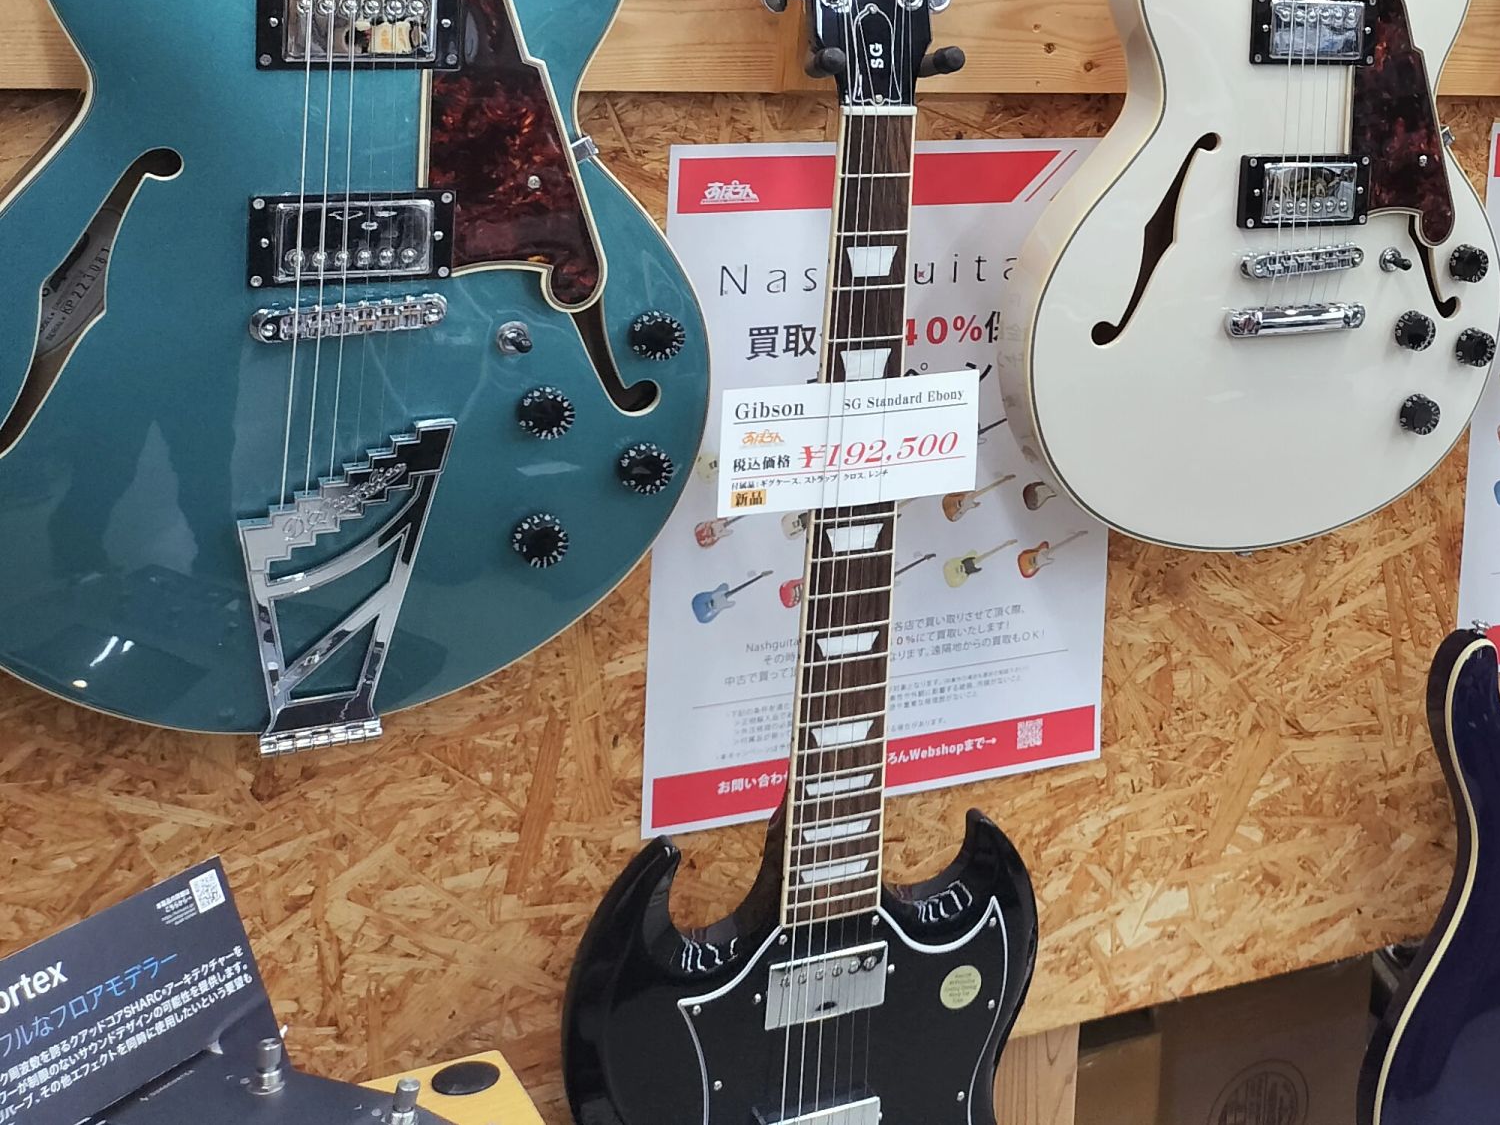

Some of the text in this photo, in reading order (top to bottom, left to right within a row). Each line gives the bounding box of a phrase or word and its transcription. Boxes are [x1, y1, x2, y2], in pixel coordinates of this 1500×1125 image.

[869, 42, 885, 69] SG
[735, 388, 964, 421] Gibson SG Standard Ebony
[733, 454, 790, 473] 税込価格
[734, 491, 765, 507] 新品
